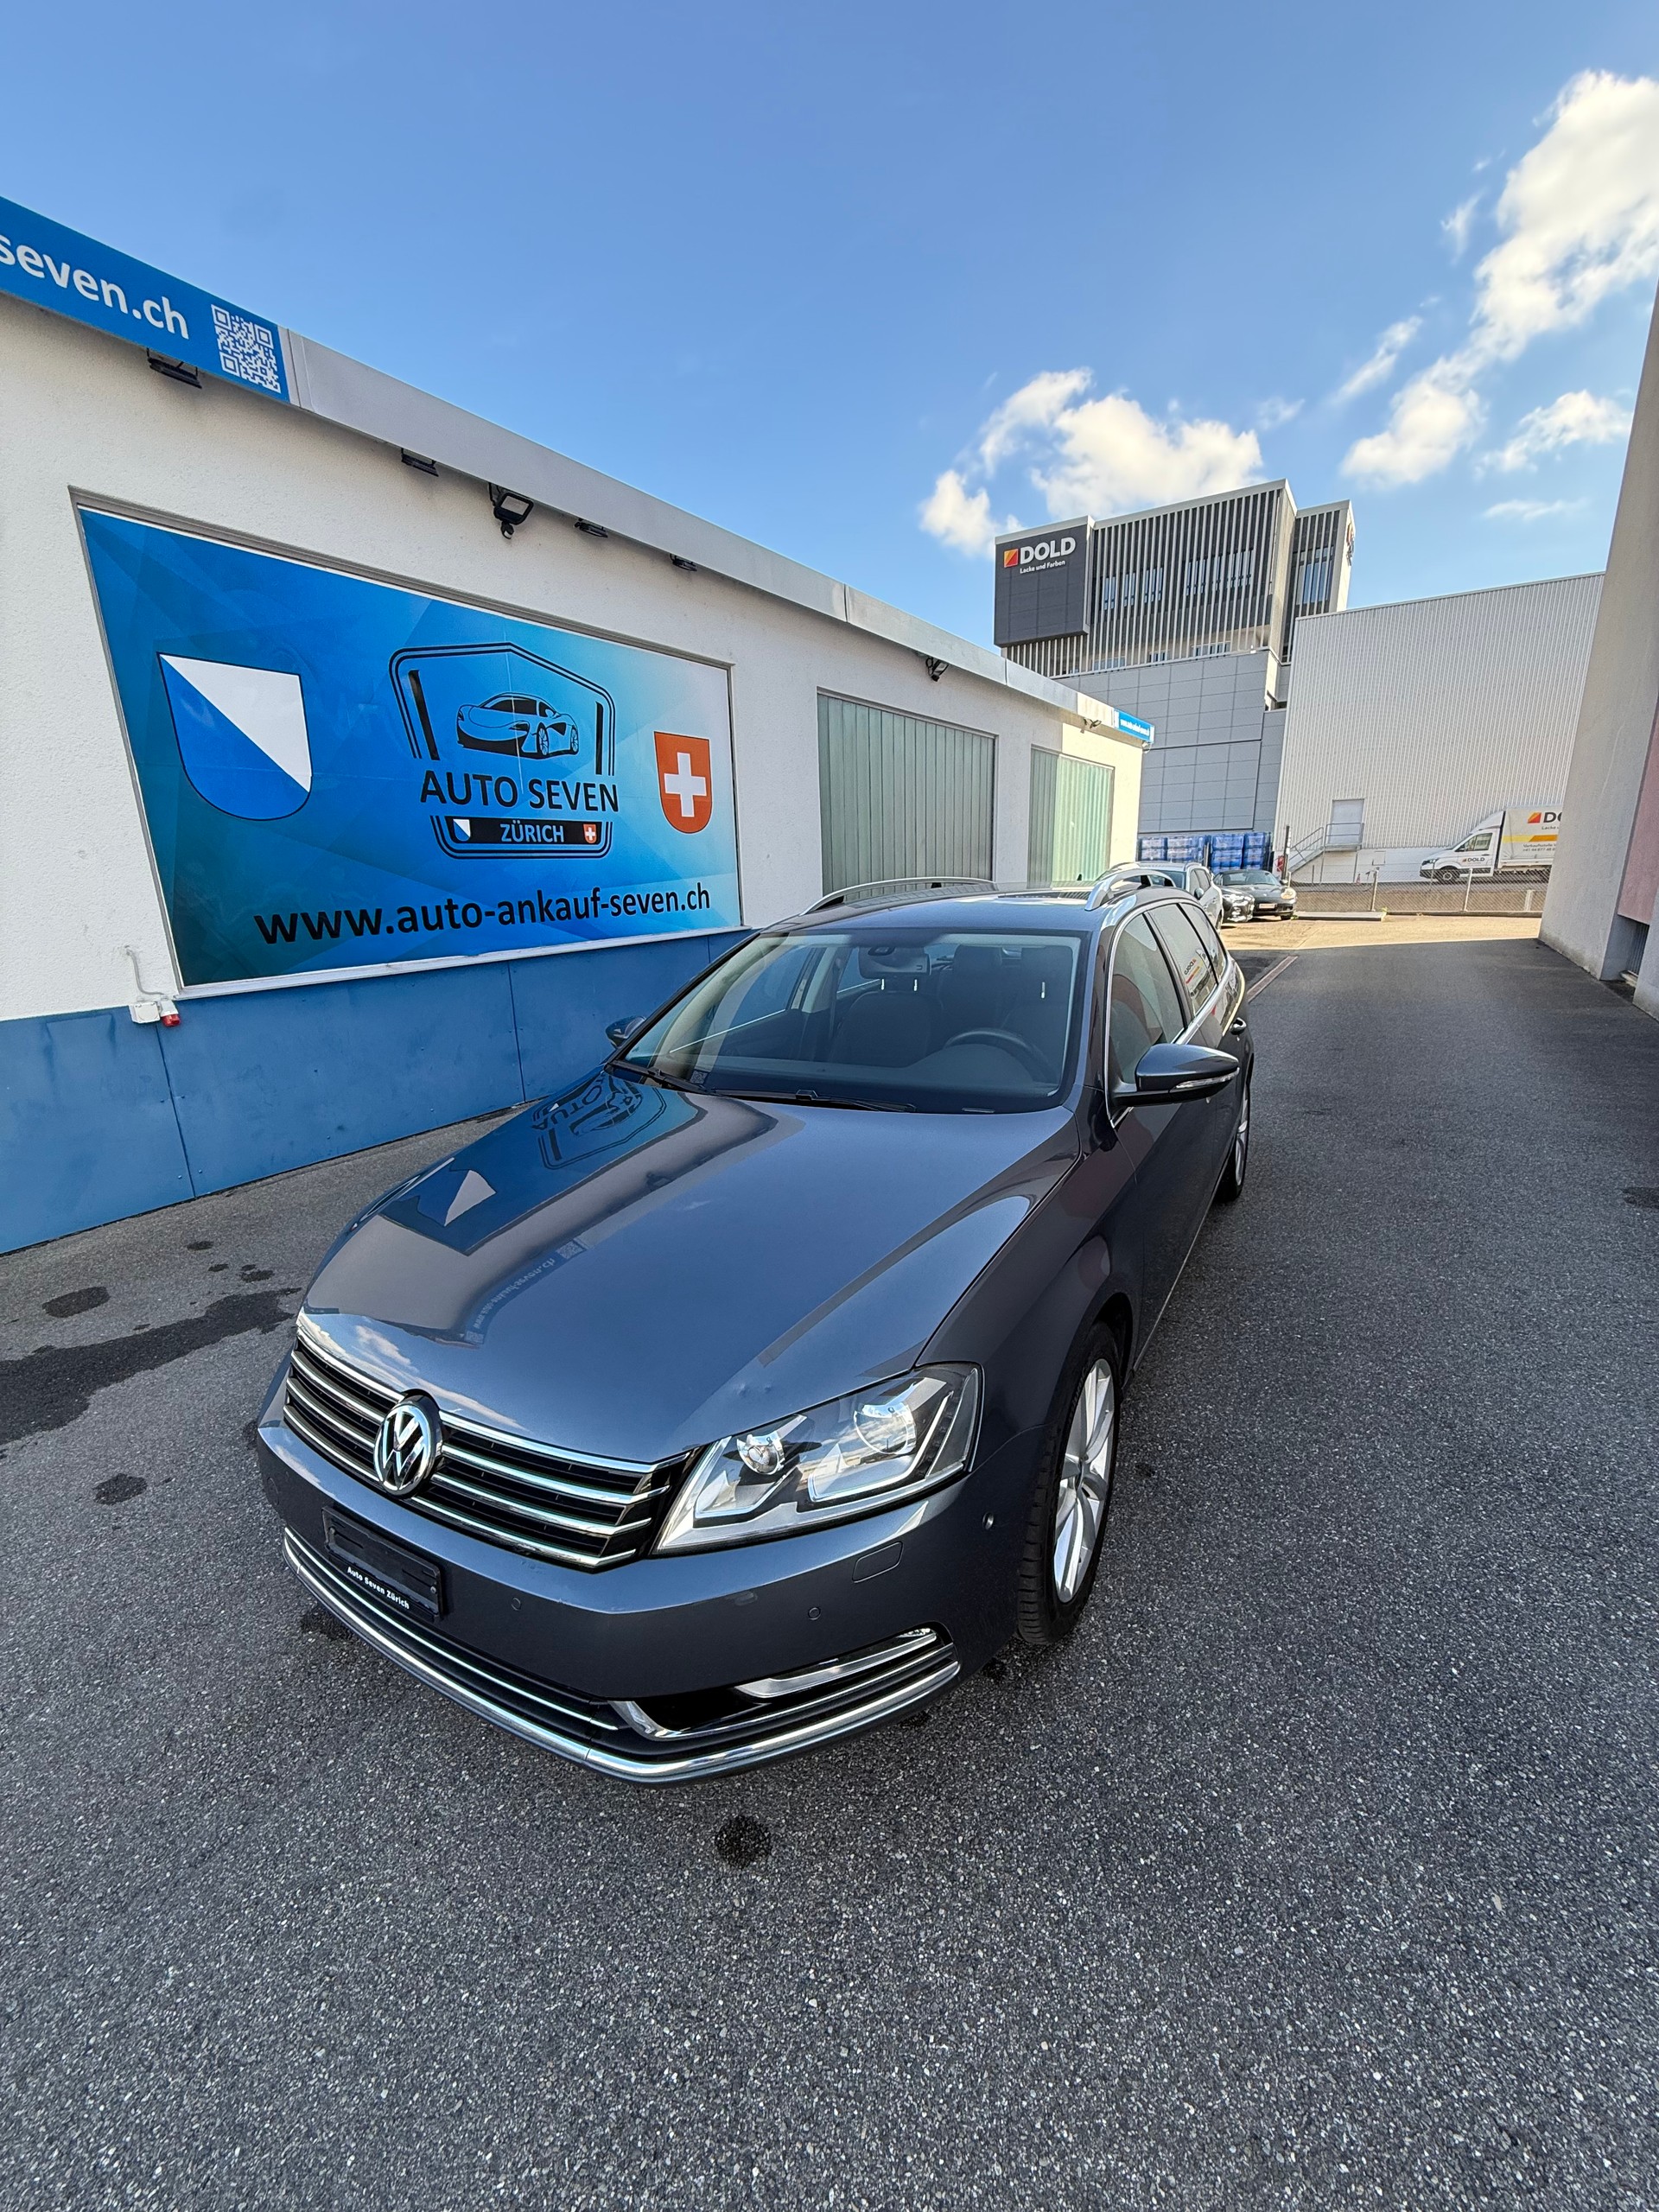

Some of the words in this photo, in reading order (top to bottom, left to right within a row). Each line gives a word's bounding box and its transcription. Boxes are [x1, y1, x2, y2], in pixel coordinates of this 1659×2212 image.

[1020, 537, 1075, 564] DOLD
[1046, 560, 1065, 569] Farben
[419, 769, 518, 808] AUTO
[528, 779, 620, 813] SEVEN
[499, 820, 565, 843] ZÜRICH
[253, 881, 711, 945] www.auto-ankauf-seven.ch
[374, 1405, 431, 1496] VW
[347, 1566, 364, 1581] Auto
[364, 1577, 385, 1595] Seven
[386, 1590, 410, 1610] Zürich
